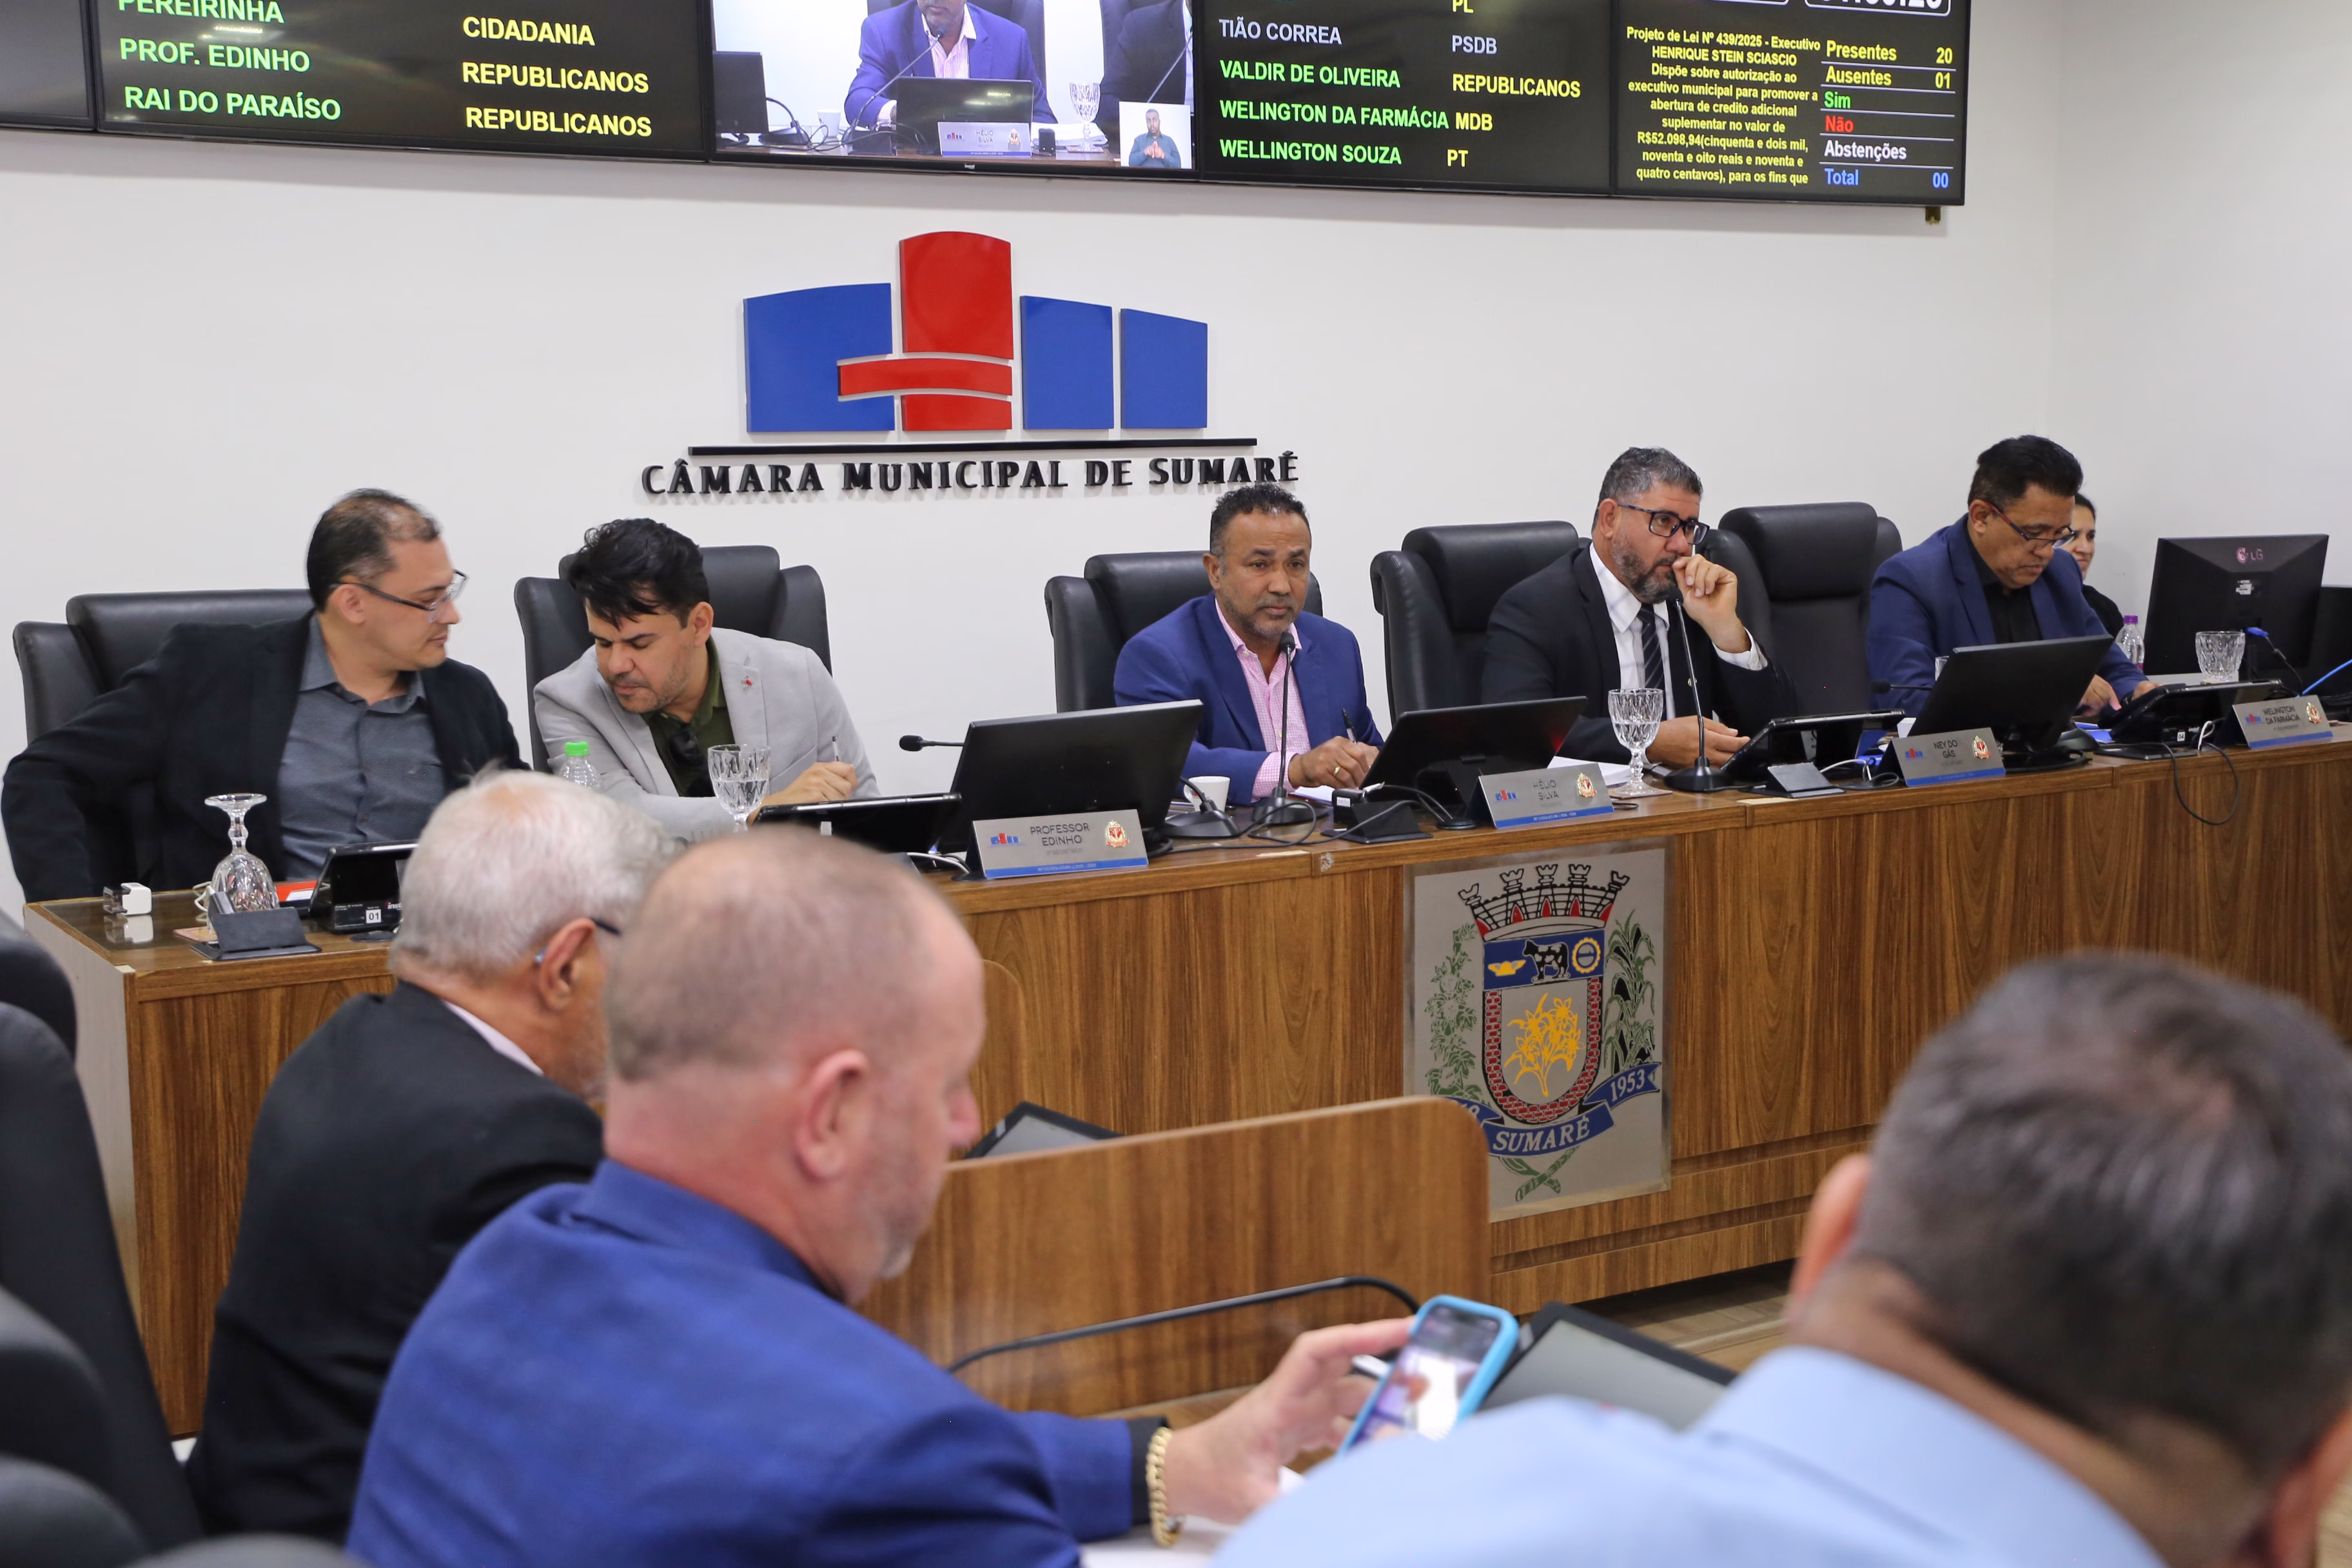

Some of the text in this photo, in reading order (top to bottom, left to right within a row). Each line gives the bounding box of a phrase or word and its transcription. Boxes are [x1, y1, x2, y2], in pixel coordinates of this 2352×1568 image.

[1453, 0, 1473, 13] PL
[463, 17, 595, 46] CIDADANIA
[1219, 17, 1342, 44] TIÃO CORREA
[1627, 26, 1665, 43] Projeto
[1667, 30, 1680, 42] de
[1683, 30, 1699, 43] Lei
[1716, 33, 1762, 47] 439/2025
[1771, 36, 1821, 50] Executivo
[120, 37, 309, 72] PROF. EDINHO
[1453, 35, 1496, 54] PSDB
[1827, 40, 1952, 64] Presentes 20
[1652, 46, 1797, 66] HENRIQUE STEIN SCIASCIO
[463, 62, 649, 93] REPUBLICANOS
[1220, 60, 1400, 88] VALDIR DE OLIVEIRA
[1652, 63, 1797, 83] Dispõe sobre autorização ao
[1826, 66, 1950, 88] Ausentes 01
[1453, 74, 1580, 97] REPUBLICANOS
[1629, 81, 1818, 101] executivo municipal para promover a
[125, 86, 340, 120] RAI DO PARAÍSO
[1651, 99, 1797, 117] abertura de credito adicional
[1824, 92, 1850, 108] Sim
[466, 107, 651, 136] REPUBLICANOS
[1220, 100, 1449, 128] WELINGTON DA FARMÁCIA
[1456, 112, 1493, 131] MDB
[1826, 115, 1854, 133] Não
[1662, 116, 1785, 133] suplementar no valor de
[1220, 139, 1402, 164] WELLINGTON SOUZA
[1757, 139, 1763, 148] e
[1766, 137, 1787, 150] dois
[1790, 139, 1808, 153] mil,
[1825, 140, 1906, 161] Abstenções
[1447, 150, 1468, 167] PT
[1643, 151, 1803, 167] noventa e oito reais e noventa e
[1636, 168, 1808, 186] quatro centavos), para os fins que
[1825, 168, 1950, 188] Total 00
[642, 450, 1298, 494] CÂMARA MUNICIPAL DE SUMARÉ
[2251, 549, 2263, 560] LG
[2262, 705, 2295, 715] WELINGTON
[1948, 740, 1957, 748] DO
[1533, 779, 1556, 789] HÉLIO
[1538, 791, 1559, 800] SILVA
[1030, 823, 1090, 836] PROFESSOR
[1042, 835, 1082, 846] EDINHO
[1611, 1069, 1645, 1101] 1953
[1493, 1115, 1590, 1152] SUMARÉ
